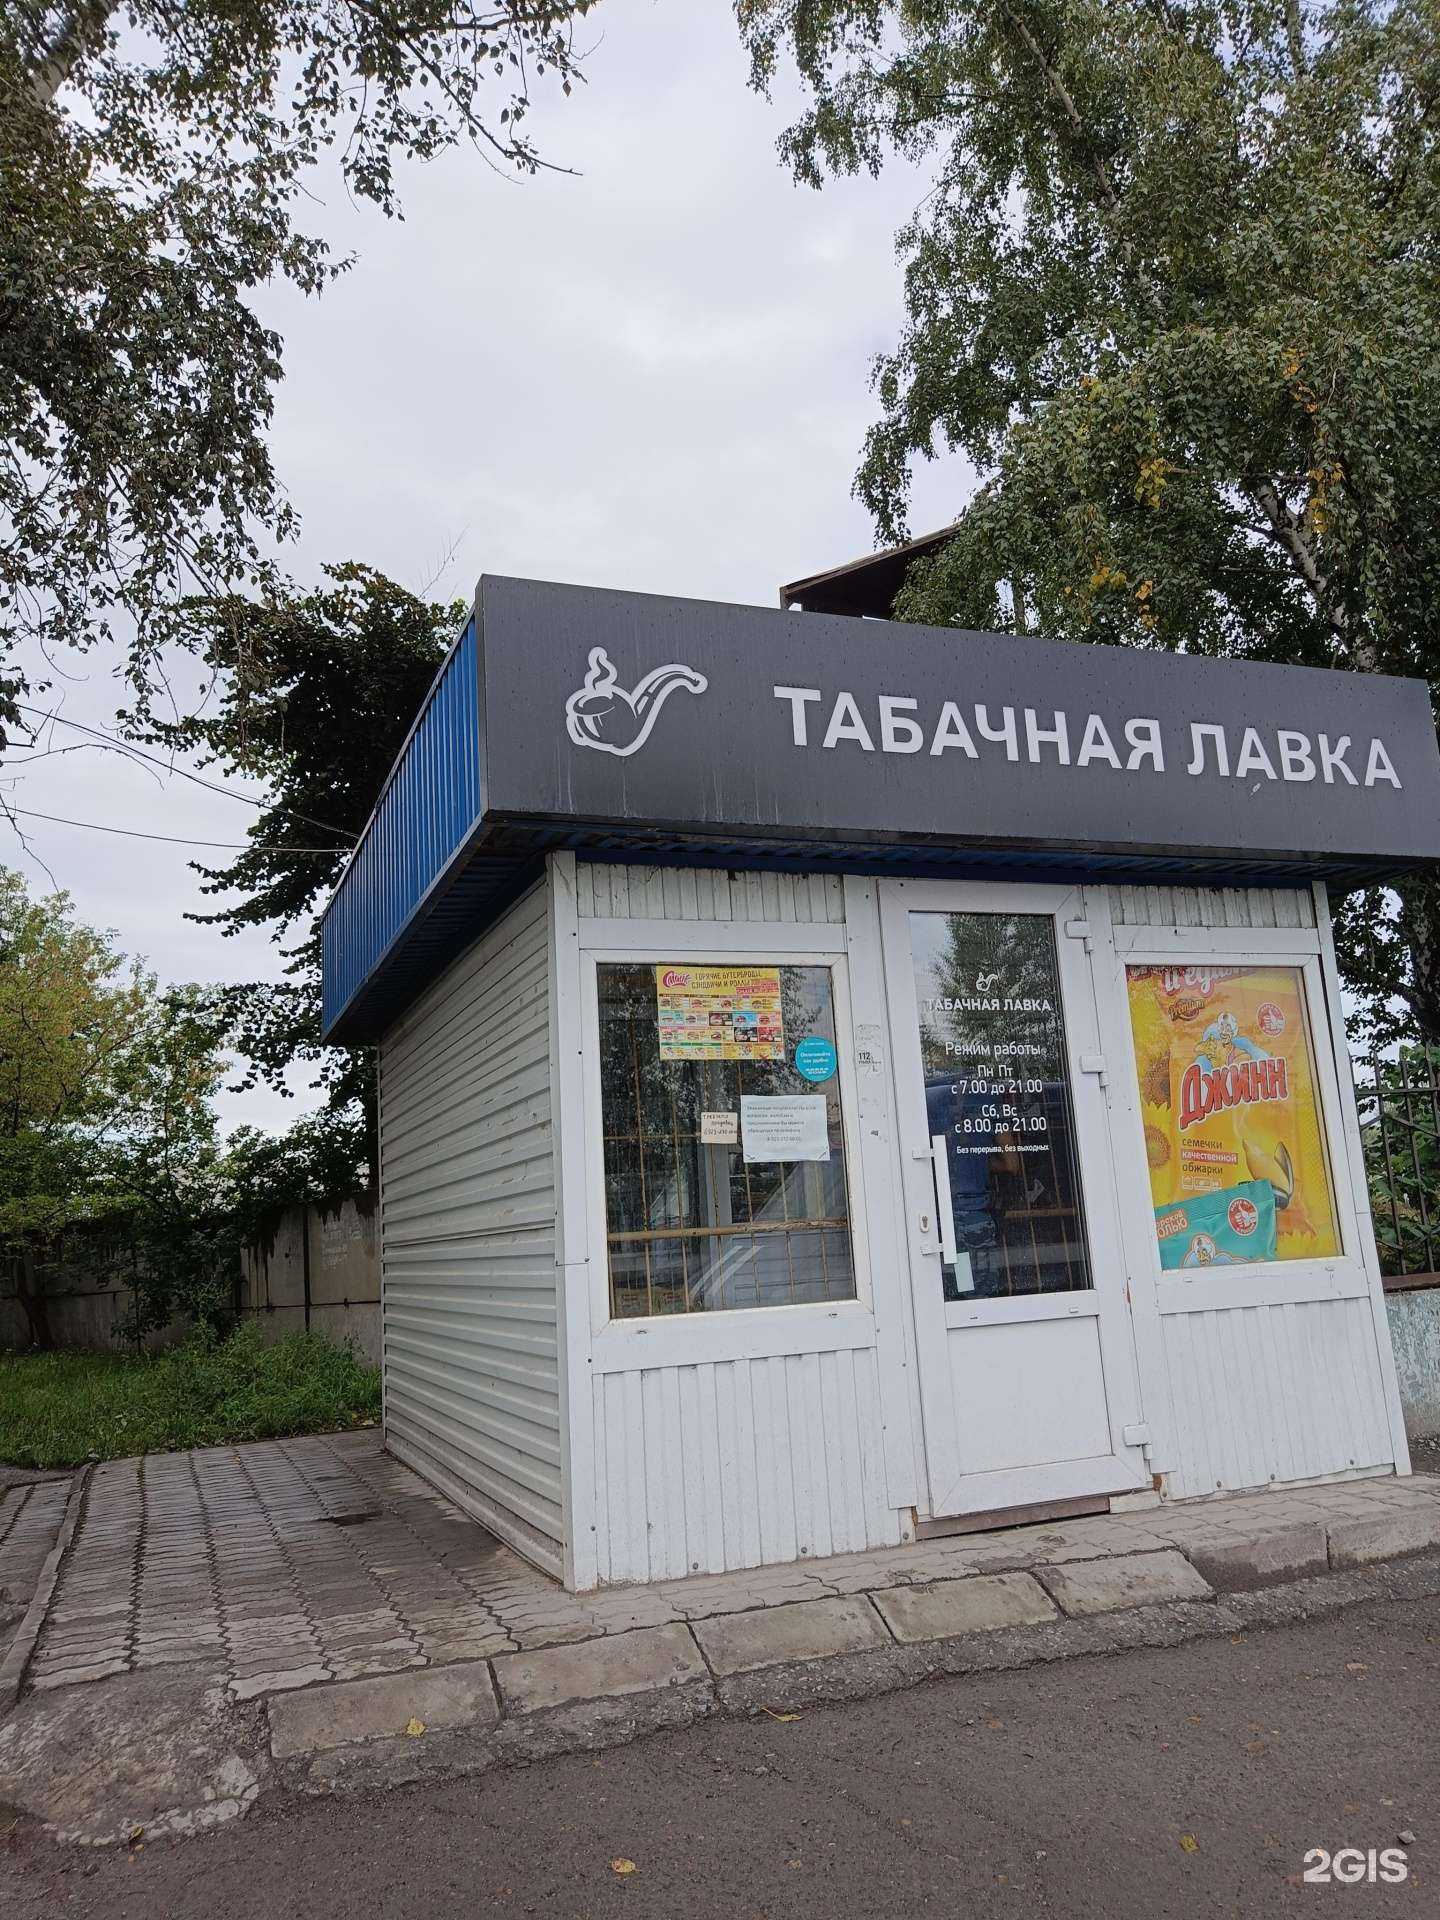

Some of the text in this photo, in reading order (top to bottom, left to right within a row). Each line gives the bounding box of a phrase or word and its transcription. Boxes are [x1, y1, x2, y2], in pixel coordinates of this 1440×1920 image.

[774, 686, 1402, 789] ТАБАЧНАЯ ЛАВКА
[929, 998, 1052, 1011] ТАБАЧНАЯ ЛАВКА
[945, 1041, 1041, 1060] Режим работы
[978, 1065, 1013, 1077] Пн Пт
[951, 1079, 1043, 1095] с 7.00 до 21.00
[981, 1104, 1017, 1118] Сб, Вс
[955, 1117, 1047, 1134] с 8.00 до 21.00
[956, 1144, 1049, 1154] Без перерыва, без выходных
[1182, 1138, 1223, 1149] семечки
[1182, 1151, 1237, 1163] качественной
[1182, 1163, 1223, 1175] обжарки
[1157, 1217, 1188, 1239] ОЛЬЮ
